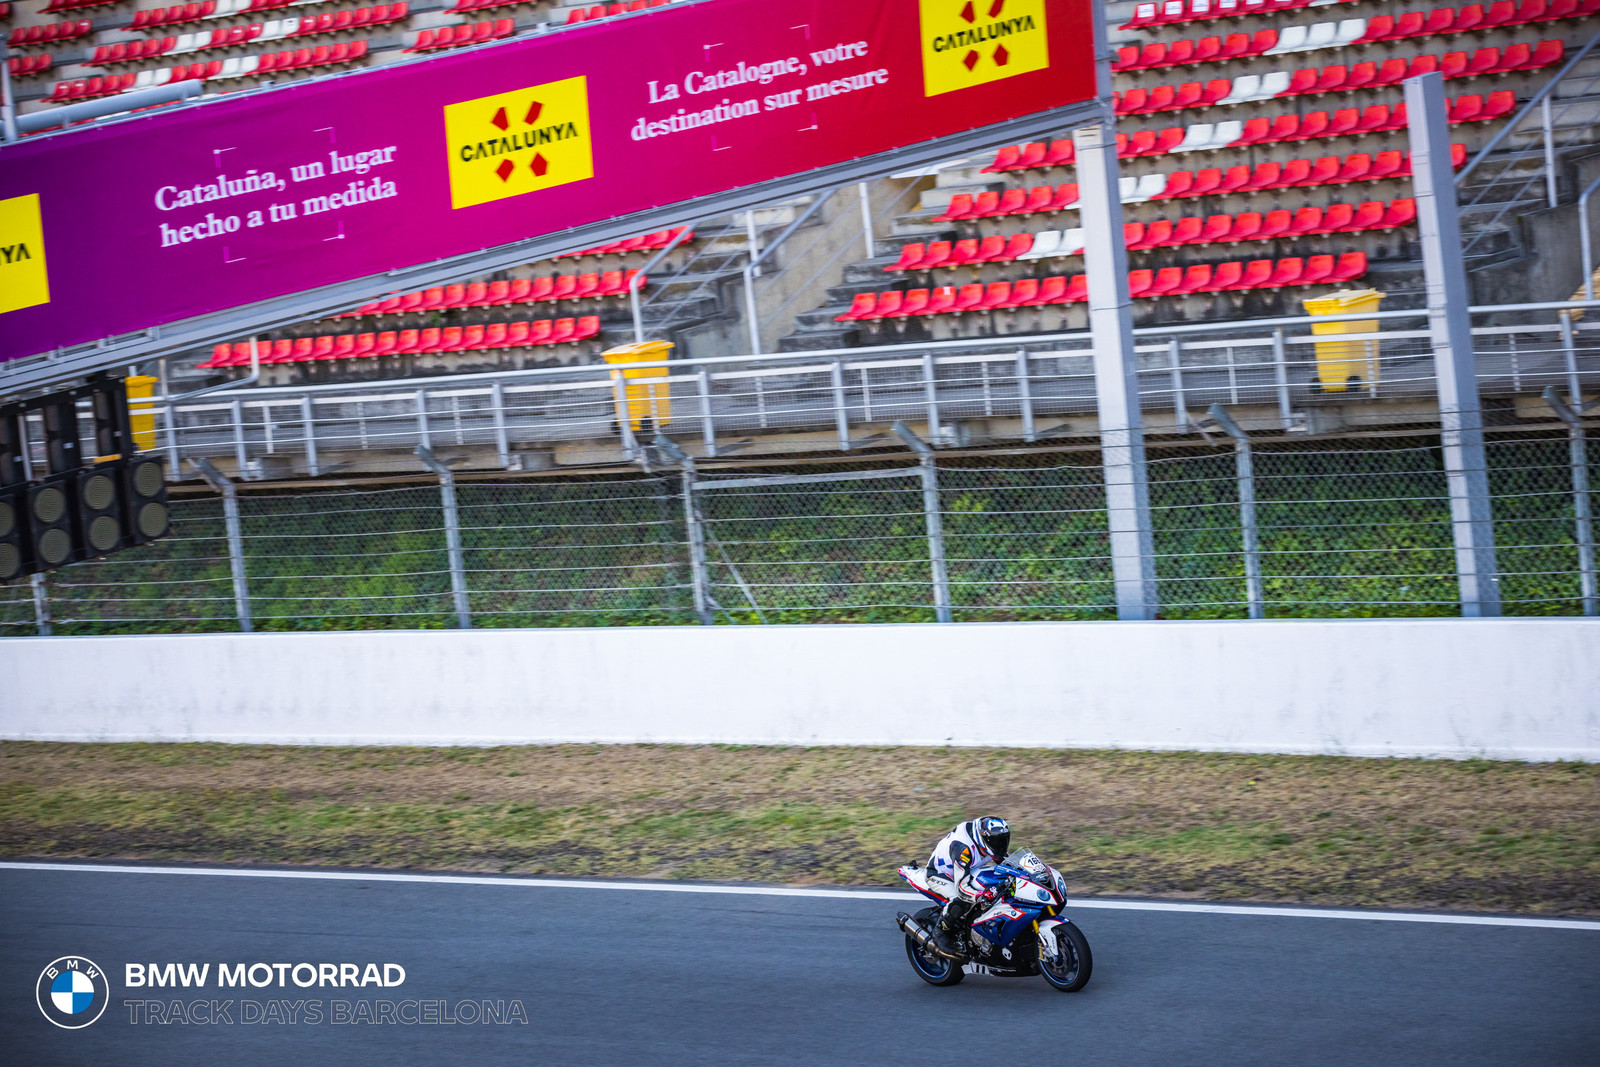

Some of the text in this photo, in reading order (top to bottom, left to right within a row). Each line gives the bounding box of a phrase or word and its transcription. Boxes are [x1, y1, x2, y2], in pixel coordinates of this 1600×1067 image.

[933, 15, 1036, 53] CATALUNYA
[646, 40, 868, 104] La Catalogne, votre
[630, 68, 889, 141] destination sur mesure
[460, 121, 578, 162] CATALUNYA
[154, 145, 397, 211] Cataluña, un lugar
[158, 176, 398, 248] hecho a tu medida
[0, 242, 32, 266] YA
